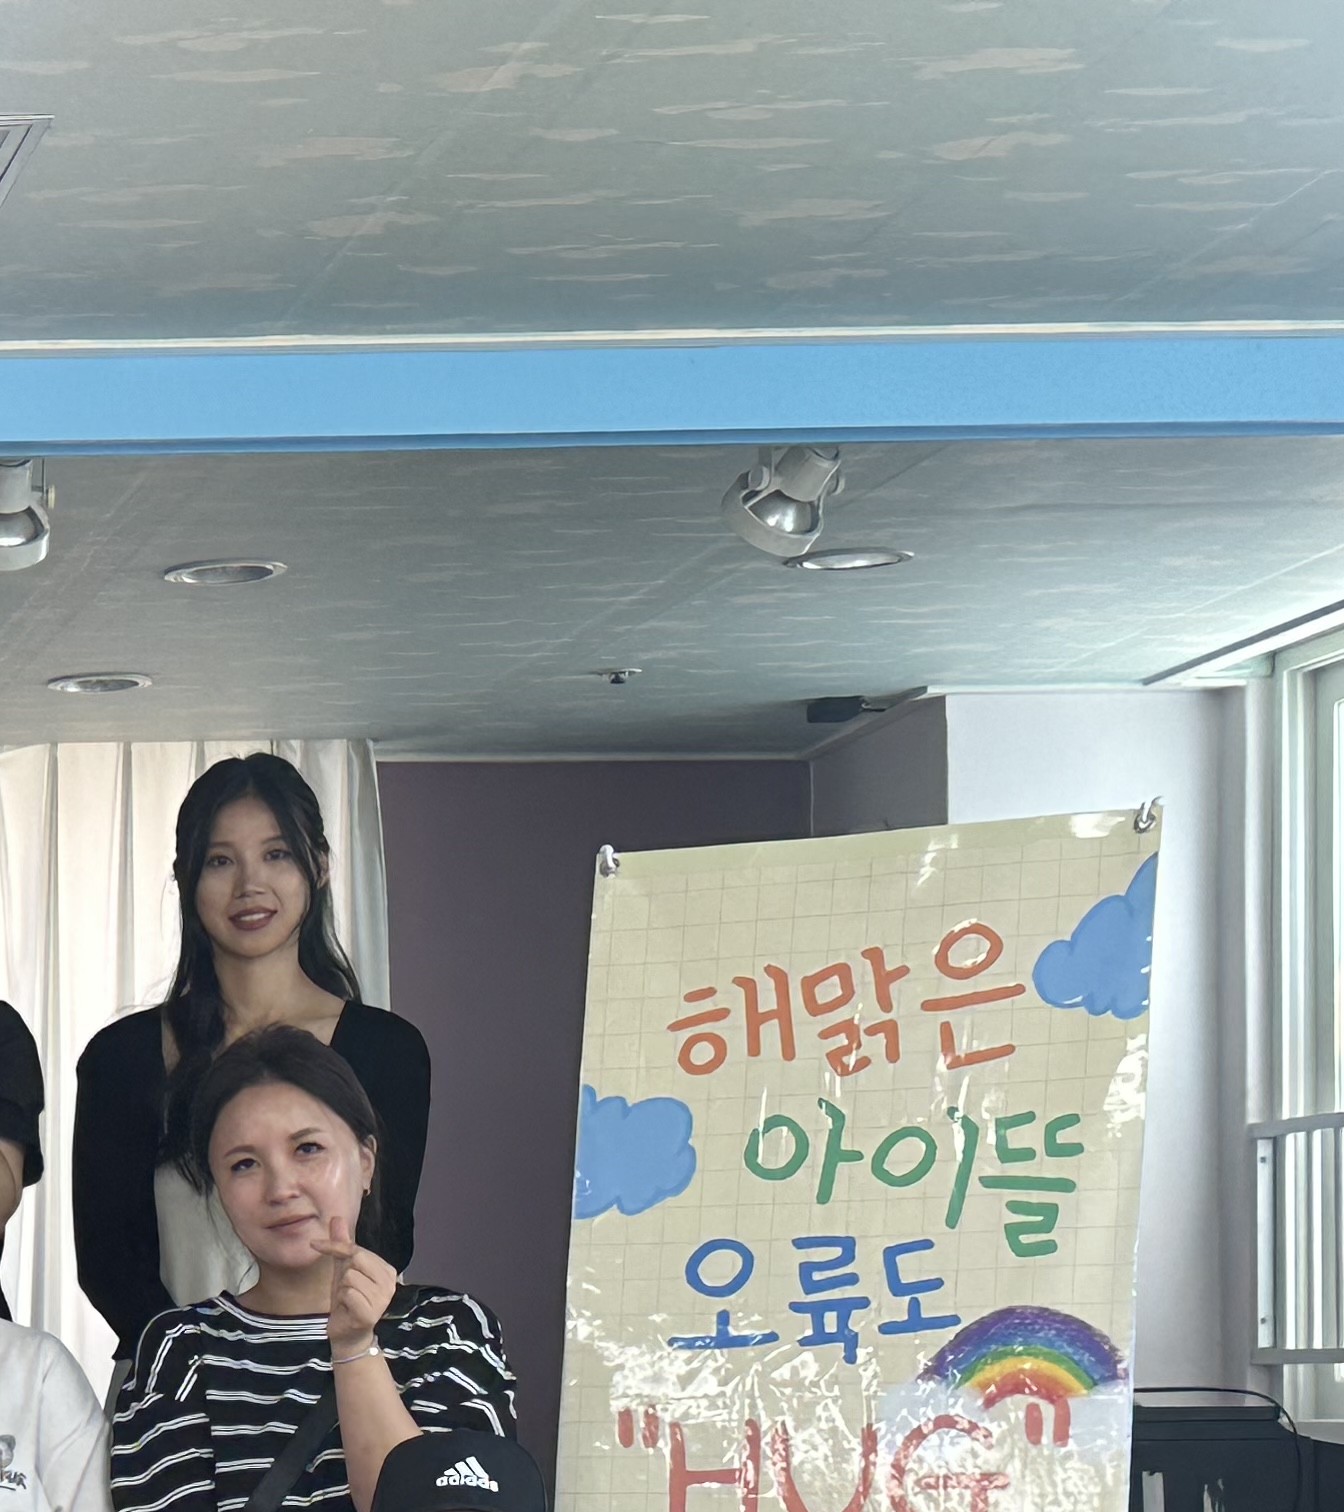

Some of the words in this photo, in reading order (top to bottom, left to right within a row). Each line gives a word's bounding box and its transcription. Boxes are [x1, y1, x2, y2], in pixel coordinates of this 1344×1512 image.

[667, 919, 1026, 1077] 해맑은
[744, 1098, 1084, 1257] 아이뜰
[667, 1236, 962, 1364] 오륙도
[435, 1473, 499, 1493] adidas
